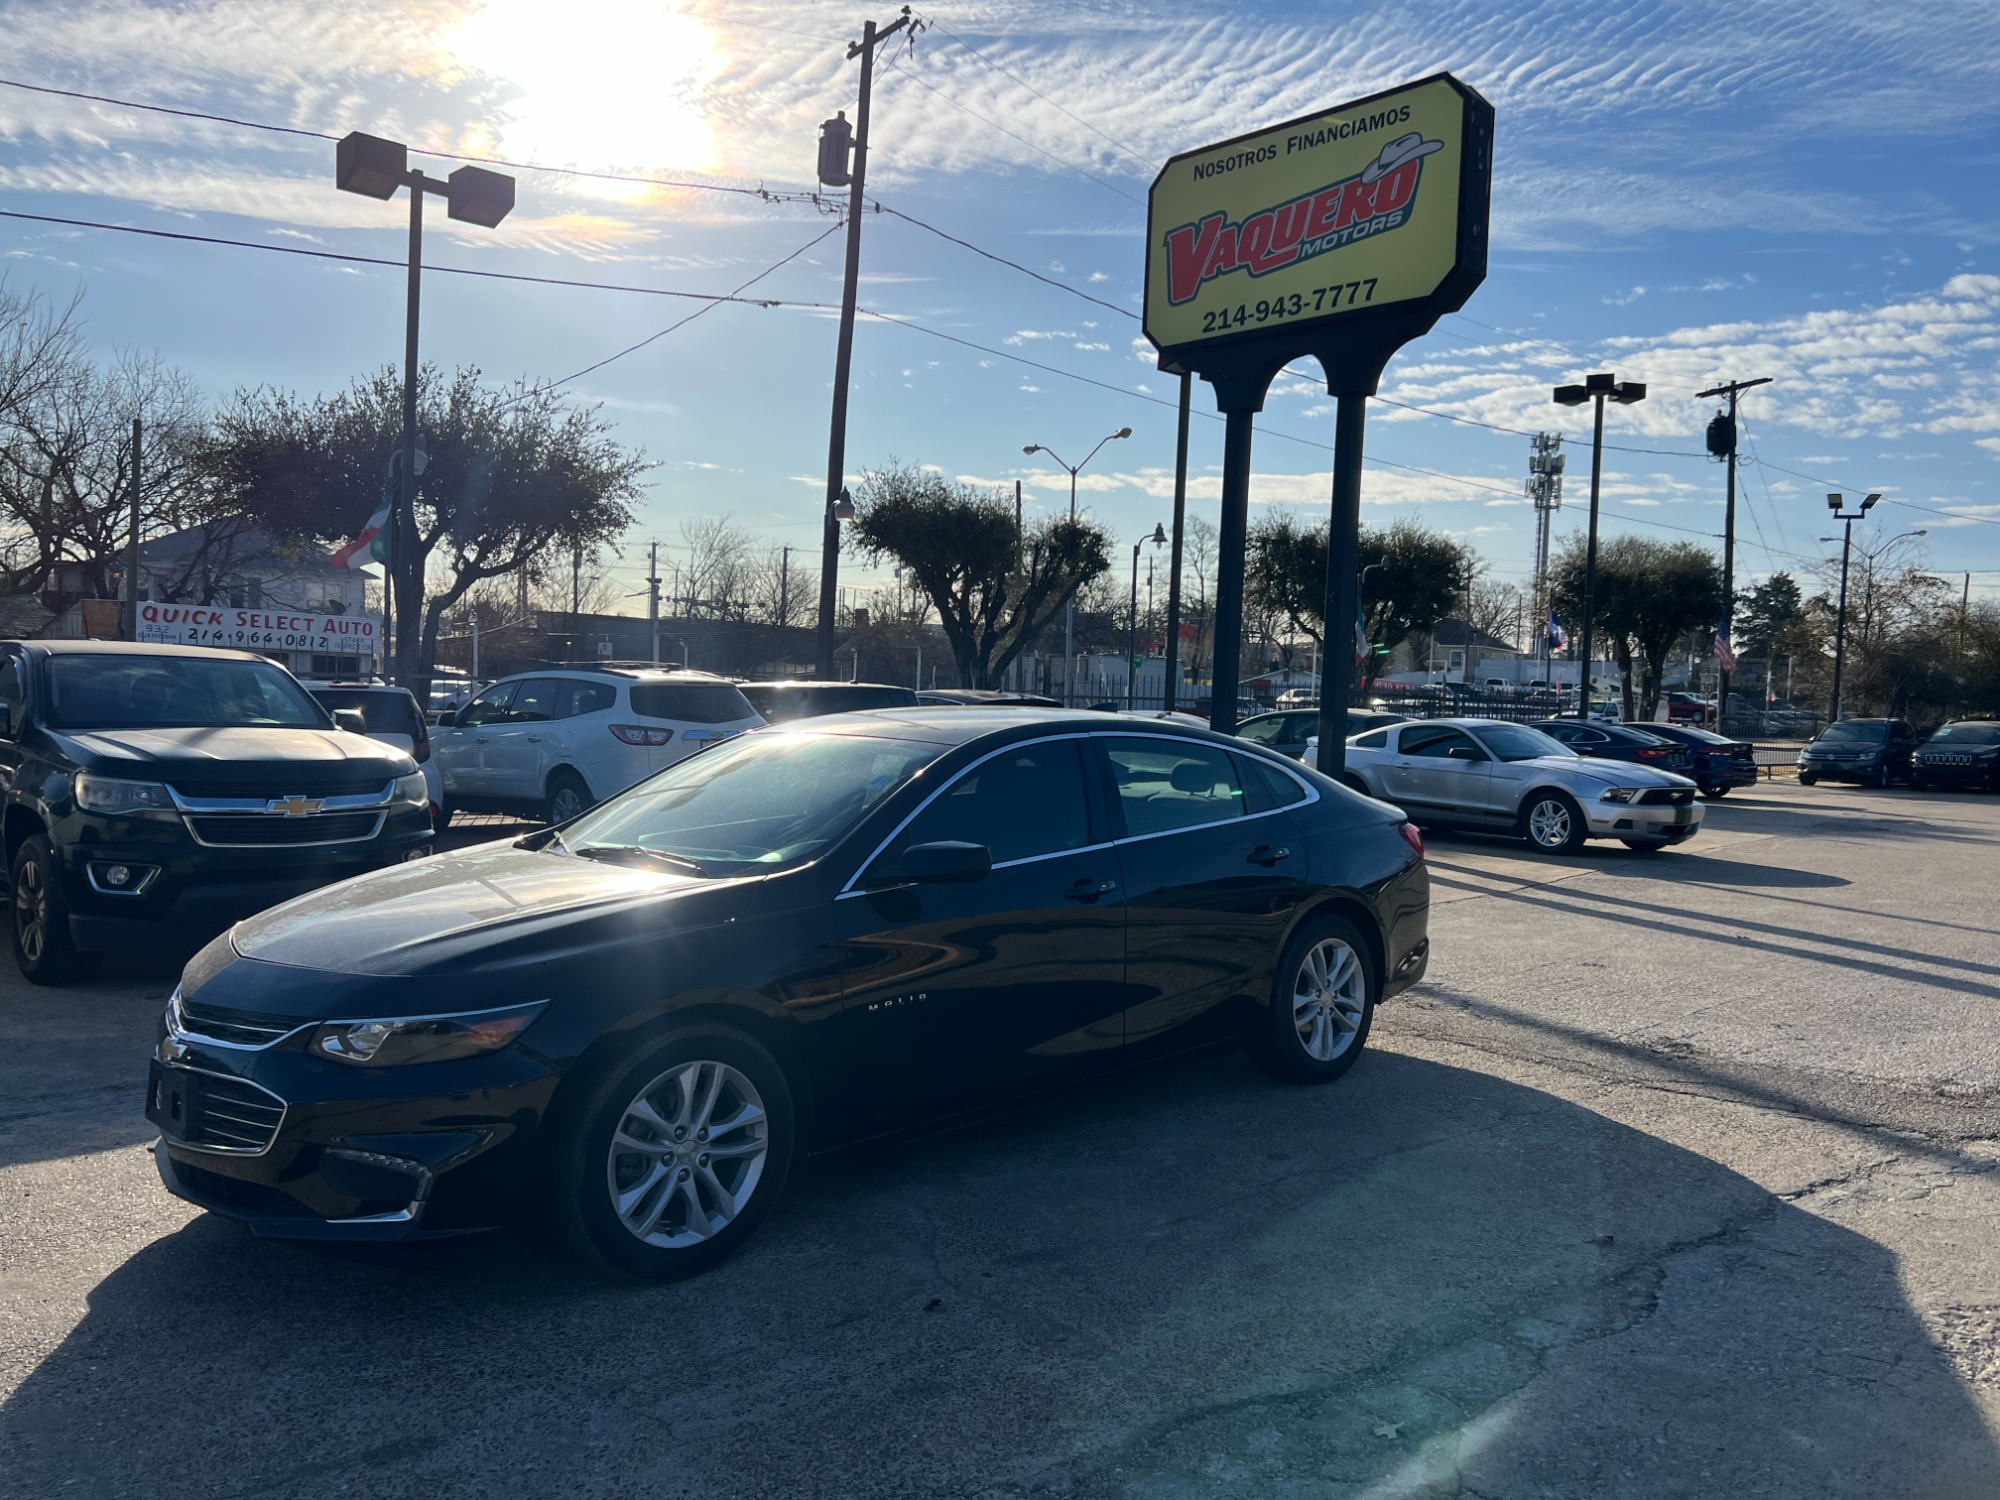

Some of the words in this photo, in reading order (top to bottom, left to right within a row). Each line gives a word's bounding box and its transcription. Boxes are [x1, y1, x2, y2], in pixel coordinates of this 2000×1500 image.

[1193, 144, 1277, 181] NOSOTROS
[1286, 105, 1411, 155] FINANCIAMOS
[1166, 157, 1421, 304] VAQUERO
[1300, 210, 1403, 258] MOTORS
[1202, 277, 1379, 334] 214-943-7777
[141, 605, 224, 626] QUICK
[235, 611, 314, 631] SELECT
[323, 618, 373, 636] AUTO
[145, 624, 170, 634] 932
[1701, 682, 1713, 694] 30
